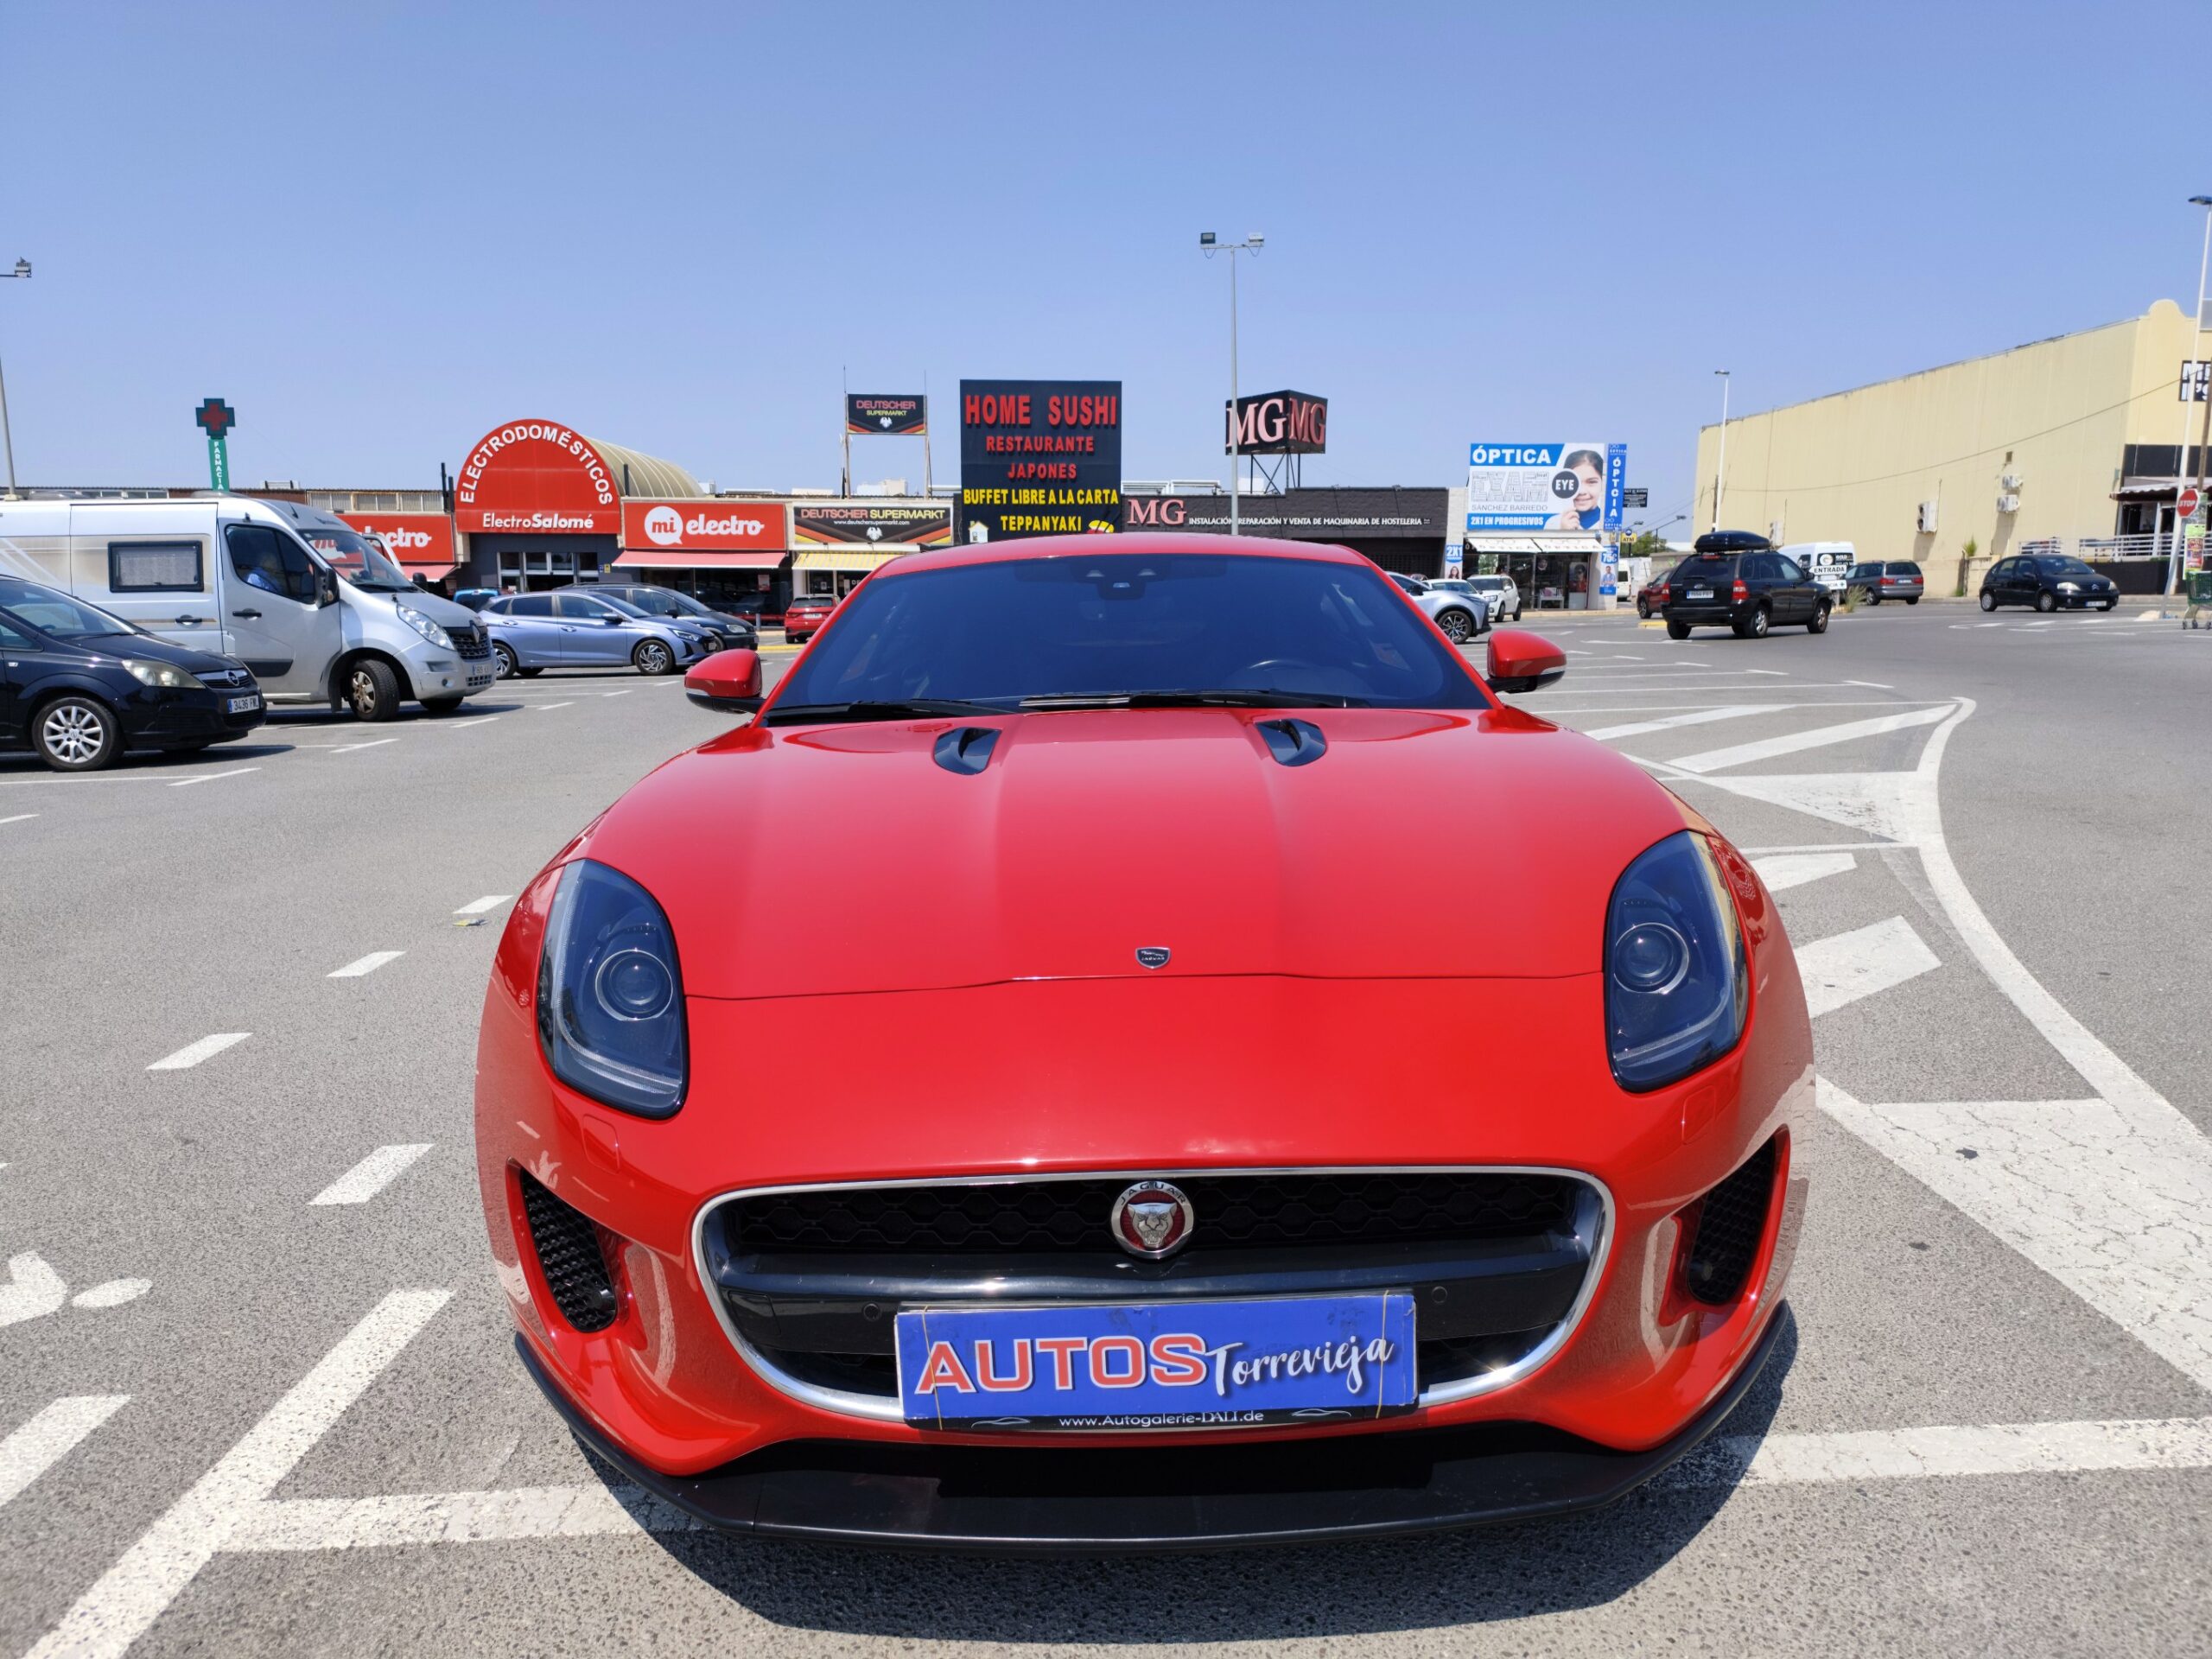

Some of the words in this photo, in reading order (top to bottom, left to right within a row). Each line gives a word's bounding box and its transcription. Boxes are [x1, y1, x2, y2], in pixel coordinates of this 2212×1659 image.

[856, 400, 916, 410] DEUTSCHER
[965, 395, 1031, 425] HOME
[1048, 396, 1117, 425] SUSHI
[1226, 398, 1287, 447] MG
[1288, 397, 1325, 445] MG
[986, 435, 1095, 452] RESTAURANTE
[1472, 445, 1551, 464] ÓPTICA
[213, 441, 224, 490] FARMACIA
[460, 424, 613, 505] ELECTRODOMÉSTICOS
[1007, 463, 1077, 480] JAPONES
[1555, 480, 1574, 490] EYE
[963, 489, 1009, 505] BUFFET
[1012, 489, 1046, 505] LIBRE
[1048, 489, 1057, 505] A
[1059, 489, 1075, 505] LA
[1077, 489, 1119, 505] CARTA
[483, 512, 594, 529] ElectroSalomé
[801, 509, 868, 518] DEUTSCHER
[870, 509, 945, 519] SUPERMARKT
[1127, 499, 1187, 525] MG
[1237, 516, 1281, 524] REPARACIÓN
[652, 517, 677, 534] mi
[685, 514, 765, 536] electro
[1001, 516, 1082, 531] TEPPANYAKI
[1484, 517, 1494, 525] EN
[1495, 517, 1544, 525] PROGRESIVOS
[1446, 545, 1463, 556] 2X1
[1121, 1181, 1185, 1205] JAGUAR
[914, 1333, 1207, 1395] AUTOS
[1205, 1335, 1395, 1396] Torrevieja
